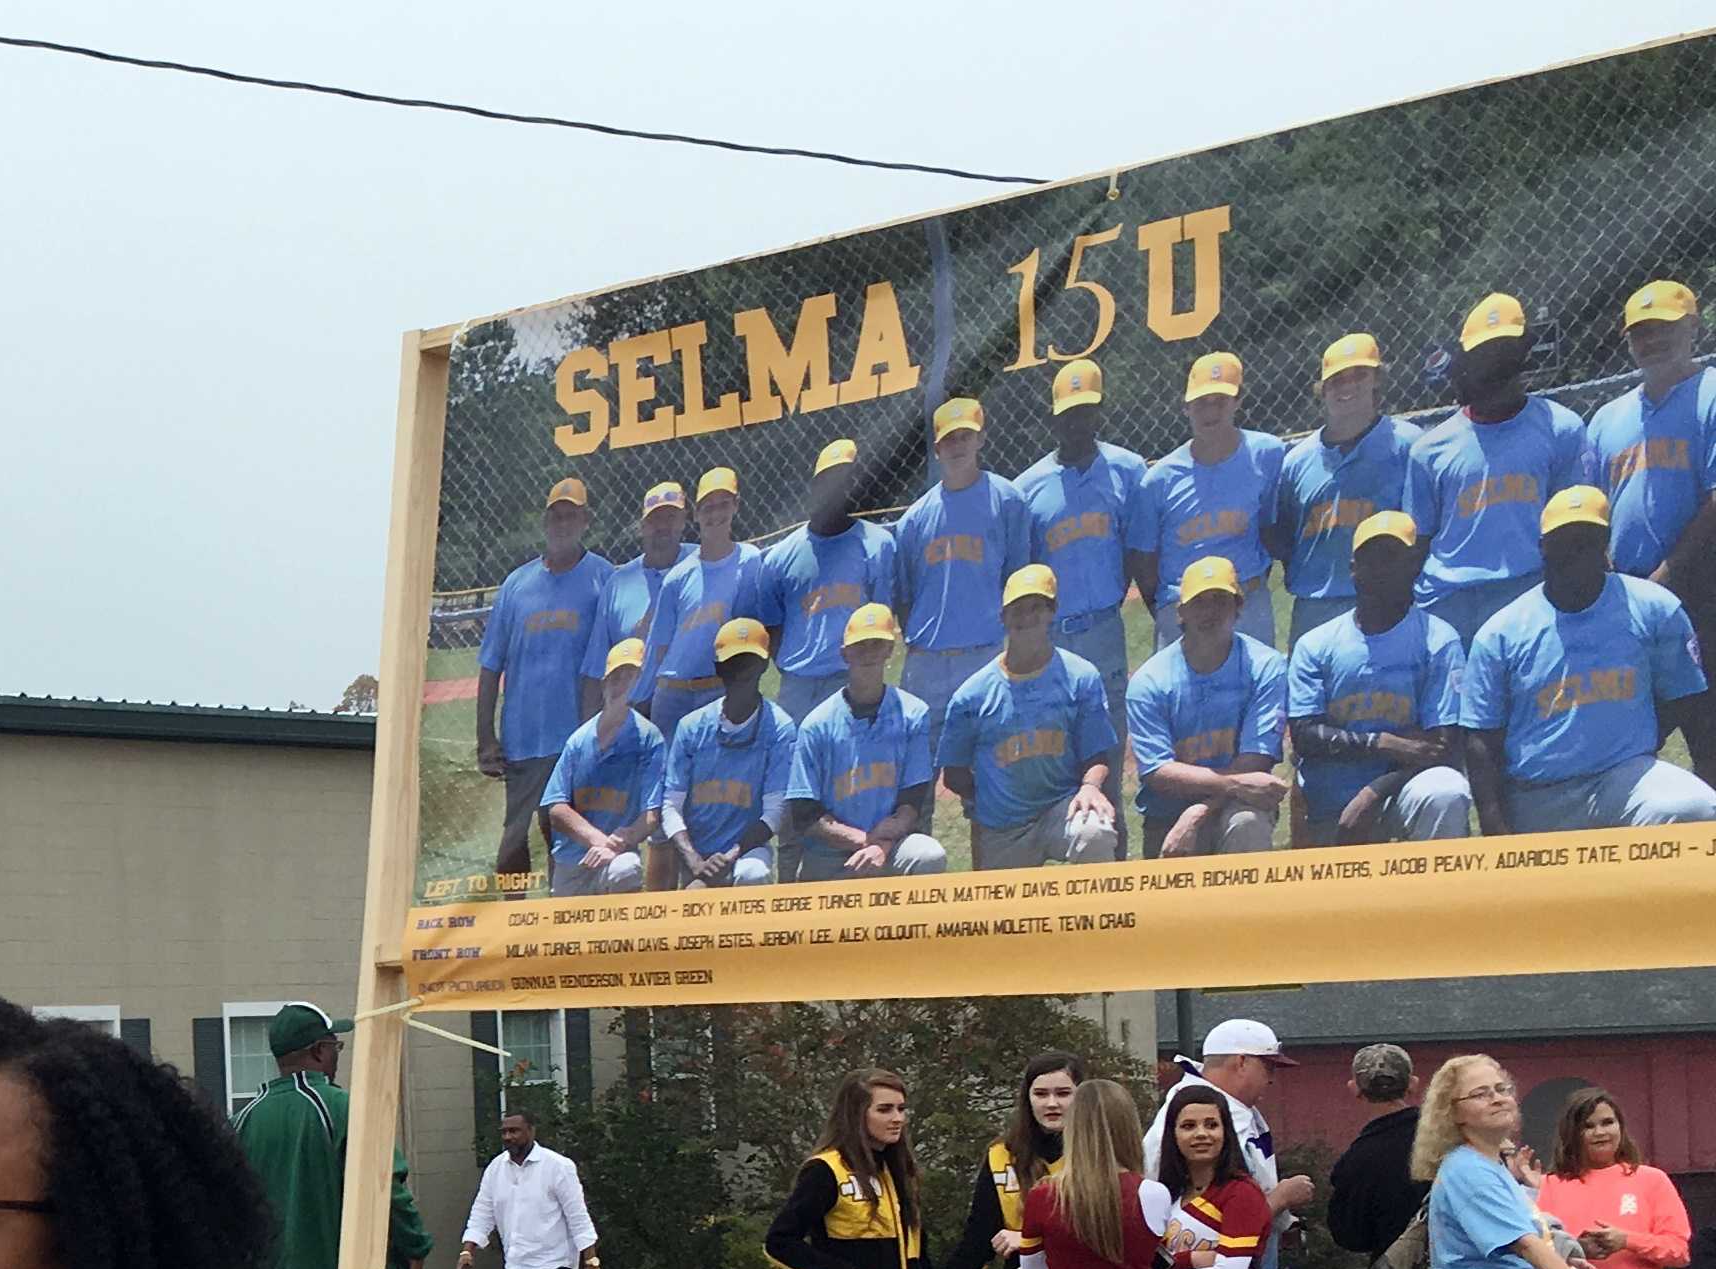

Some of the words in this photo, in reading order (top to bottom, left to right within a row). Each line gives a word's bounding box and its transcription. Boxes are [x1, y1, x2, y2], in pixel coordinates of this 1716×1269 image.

[554, 281, 920, 456] SELMA
[1003, 222, 1123, 372] 15
[1138, 205, 1231, 341] U
[509, 912, 539, 926] COACH
[554, 908, 594, 925] RICHARD
[634, 905, 666, 919] COACH
[772, 896, 812, 912] GEORGE
[953, 884, 1016, 902] MATTHEW
[1066, 876, 1134, 895] OCTAVIOUS
[1203, 868, 1258, 887] RICHARD
[1265, 865, 1303, 884] ALAN
[1379, 857, 1426, 876] JACOB
[1629, 841, 1681, 861] COACH
[674, 935, 714, 950] JOSEPH
[759, 930, 803, 947] JEREMY
[839, 927, 869, 942] ALEX
[936, 920, 988, 938] AMARIAN
[1058, 915, 1094, 931] TEVIN
[1099, 912, 1136, 929] CRAIG
[676, 970, 713, 985] GREEN
